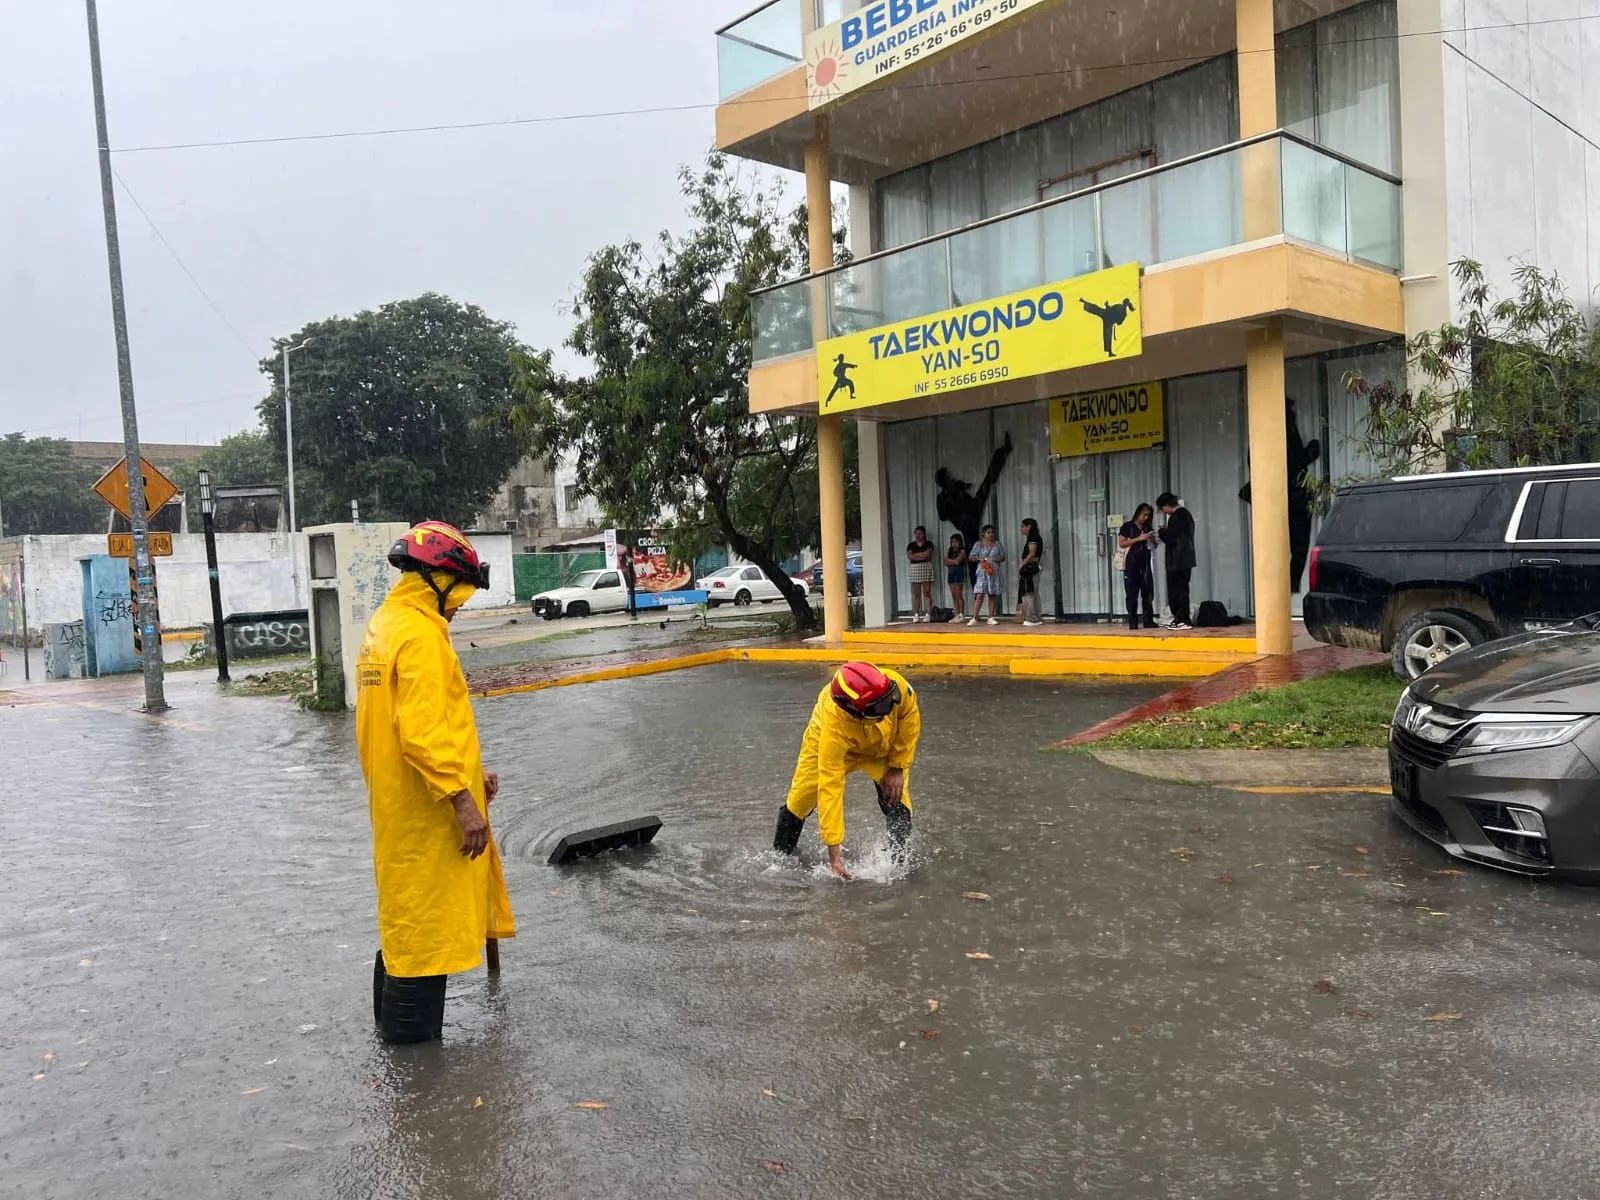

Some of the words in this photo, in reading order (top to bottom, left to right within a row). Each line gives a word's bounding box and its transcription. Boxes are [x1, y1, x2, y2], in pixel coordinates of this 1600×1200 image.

[854, 12, 946, 65] GUARDERÍA
[952, 0, 985, 18] INF
[875, 56, 900, 74] INF:
[869, 292, 1064, 360] TAEKWONDO
[921, 339, 1000, 374] YAN-SO
[914, 382, 929, 393] INF
[934, 379, 947, 390] 55
[950, 372, 977, 387] 2666
[980, 366, 1009, 381] 6950
[1061, 387, 1149, 424] TAEKWONDO
[1083, 419, 1129, 439] YAN-SO
[647, 547, 666, 555] PIZZA
